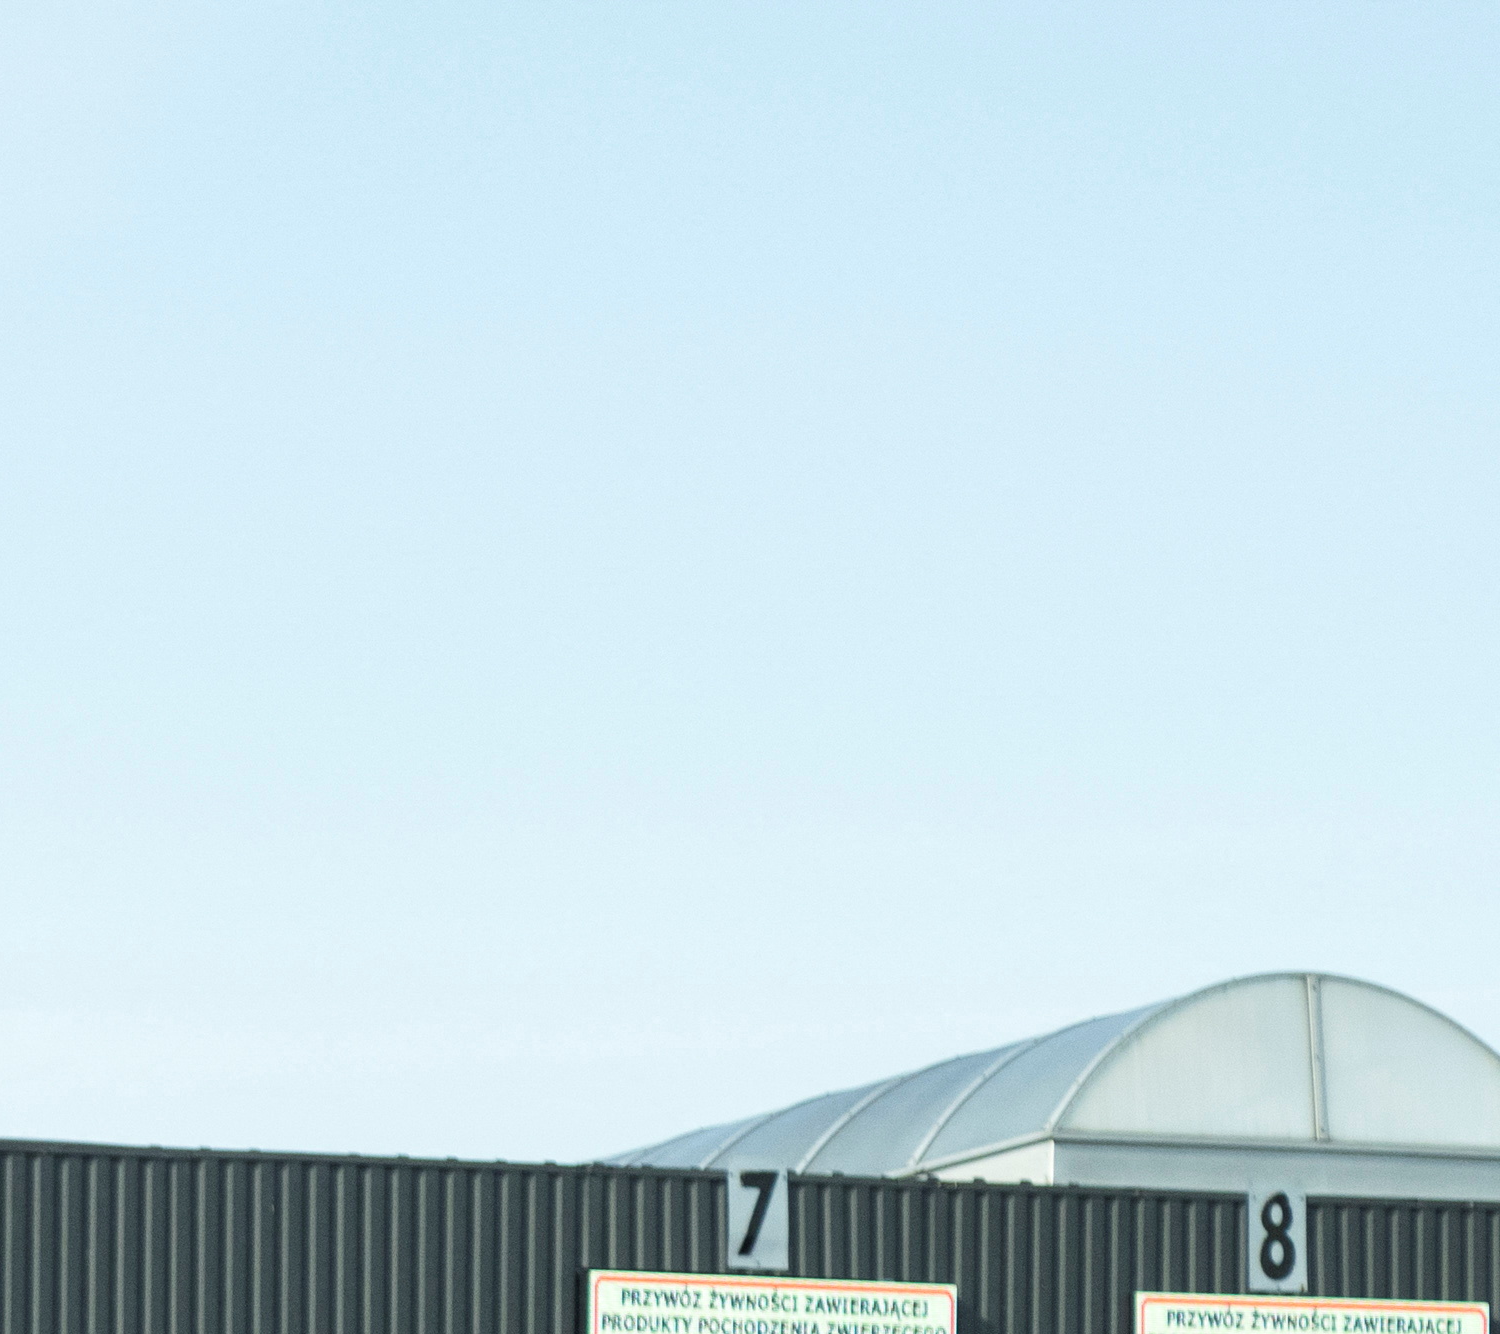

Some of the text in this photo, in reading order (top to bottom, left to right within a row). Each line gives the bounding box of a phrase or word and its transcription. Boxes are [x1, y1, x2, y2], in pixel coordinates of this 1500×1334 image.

[738, 1171, 779, 1256] 7
[1261, 1191, 1296, 1280] 8
[621, 1284, 929, 1320] PRZYWÓZ ŻYWNOŚCI ZAWIERAJĄCEJ
[1167, 1305, 1244, 1329] PRZYWÓZ
[1252, 1306, 1336, 1331] ŻYWNOŚCI
[602, 1314, 692, 1333] PRODUKTY
